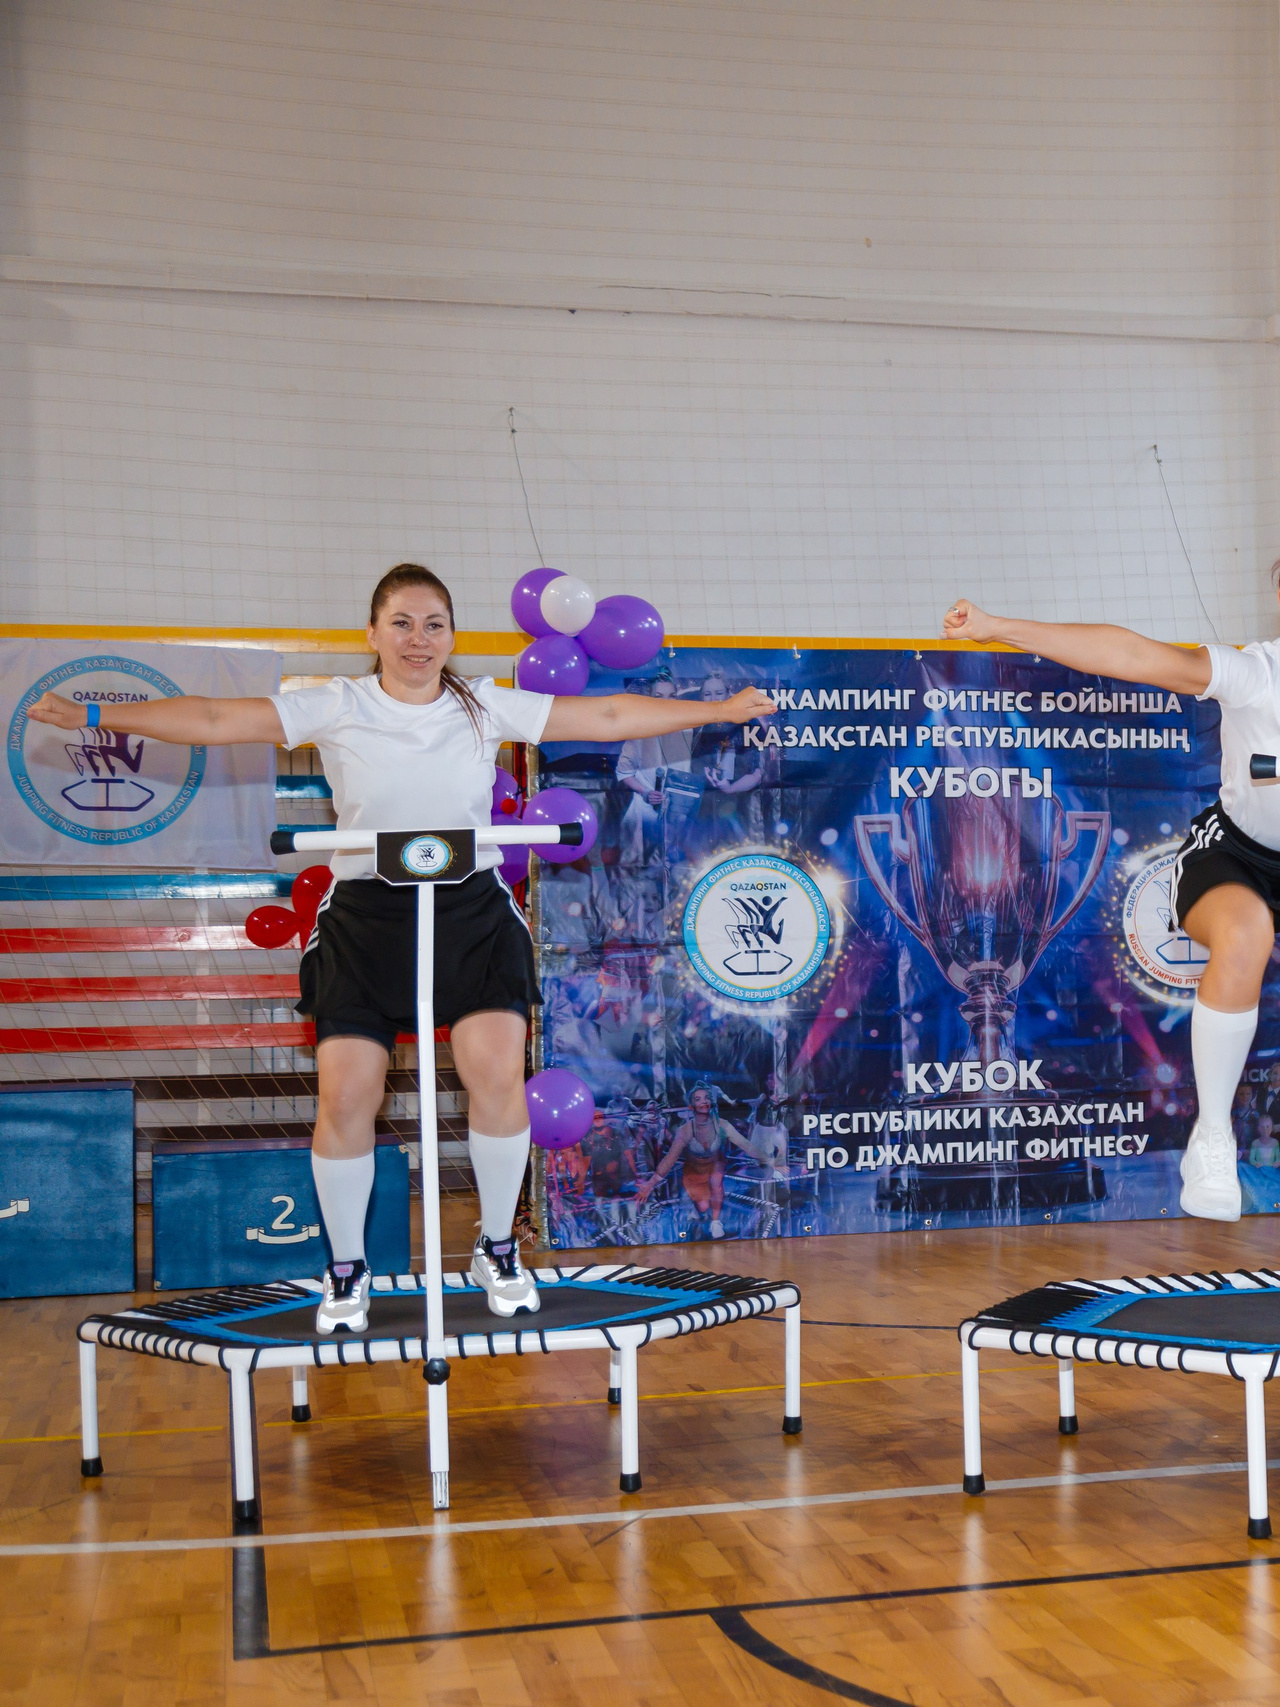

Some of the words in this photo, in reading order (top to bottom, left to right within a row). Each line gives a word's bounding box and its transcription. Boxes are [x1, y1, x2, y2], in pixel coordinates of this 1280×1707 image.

[40, 662, 83, 690] ФИТНЕС
[73, 691, 149, 703] QAZAQSTAN
[922, 688, 1033, 712] ФИТНЕС
[1040, 686, 1183, 714] БОЙЫНША
[743, 725, 908, 751] ҚАЗАҚСТАН
[916, 726, 1191, 753] РЕСПУБЛИКАСЫНЫҢ
[889, 766, 1053, 799] КУБОГЫ
[17, 774, 49, 815] JUMPING
[48, 812, 88, 838] FITNESS
[90, 827, 143, 841] REPUBLIC
[144, 820, 158, 832] OF
[158, 770, 200, 824] KAZAKSTAN
[686, 882, 710, 931] ДЖАМПИНГ
[709, 861, 741, 883] ФИТНЕС
[792, 871, 827, 932] РЕСПУБЛИКАСЫ
[730, 882, 787, 892] QAZAQSTAN
[1126, 869, 1152, 919] ФЕДЕРАЦИЯ
[691, 952, 717, 982] JUMPING
[715, 979, 744, 997] FITNESS
[745, 988, 781, 999] REPUBLIC
[781, 983, 792, 992] OF
[792, 942, 825, 985] KAZAKHSTAN
[1128, 933, 1150, 967] RUSSIAN
[1149, 966, 1183, 985] JUMPING
[907, 1059, 1046, 1094] КУБОК
[803, 1108, 982, 1136] РЕСПУБЛИКИ
[989, 1101, 1145, 1128] КАЗАХСТАН
[807, 1146, 849, 1170] ПО
[855, 1139, 1019, 1171] ДЖАМПИНГ
[1025, 1134, 1150, 1161] ФИТНЕСУ
[271, 1195, 295, 1229] 2
